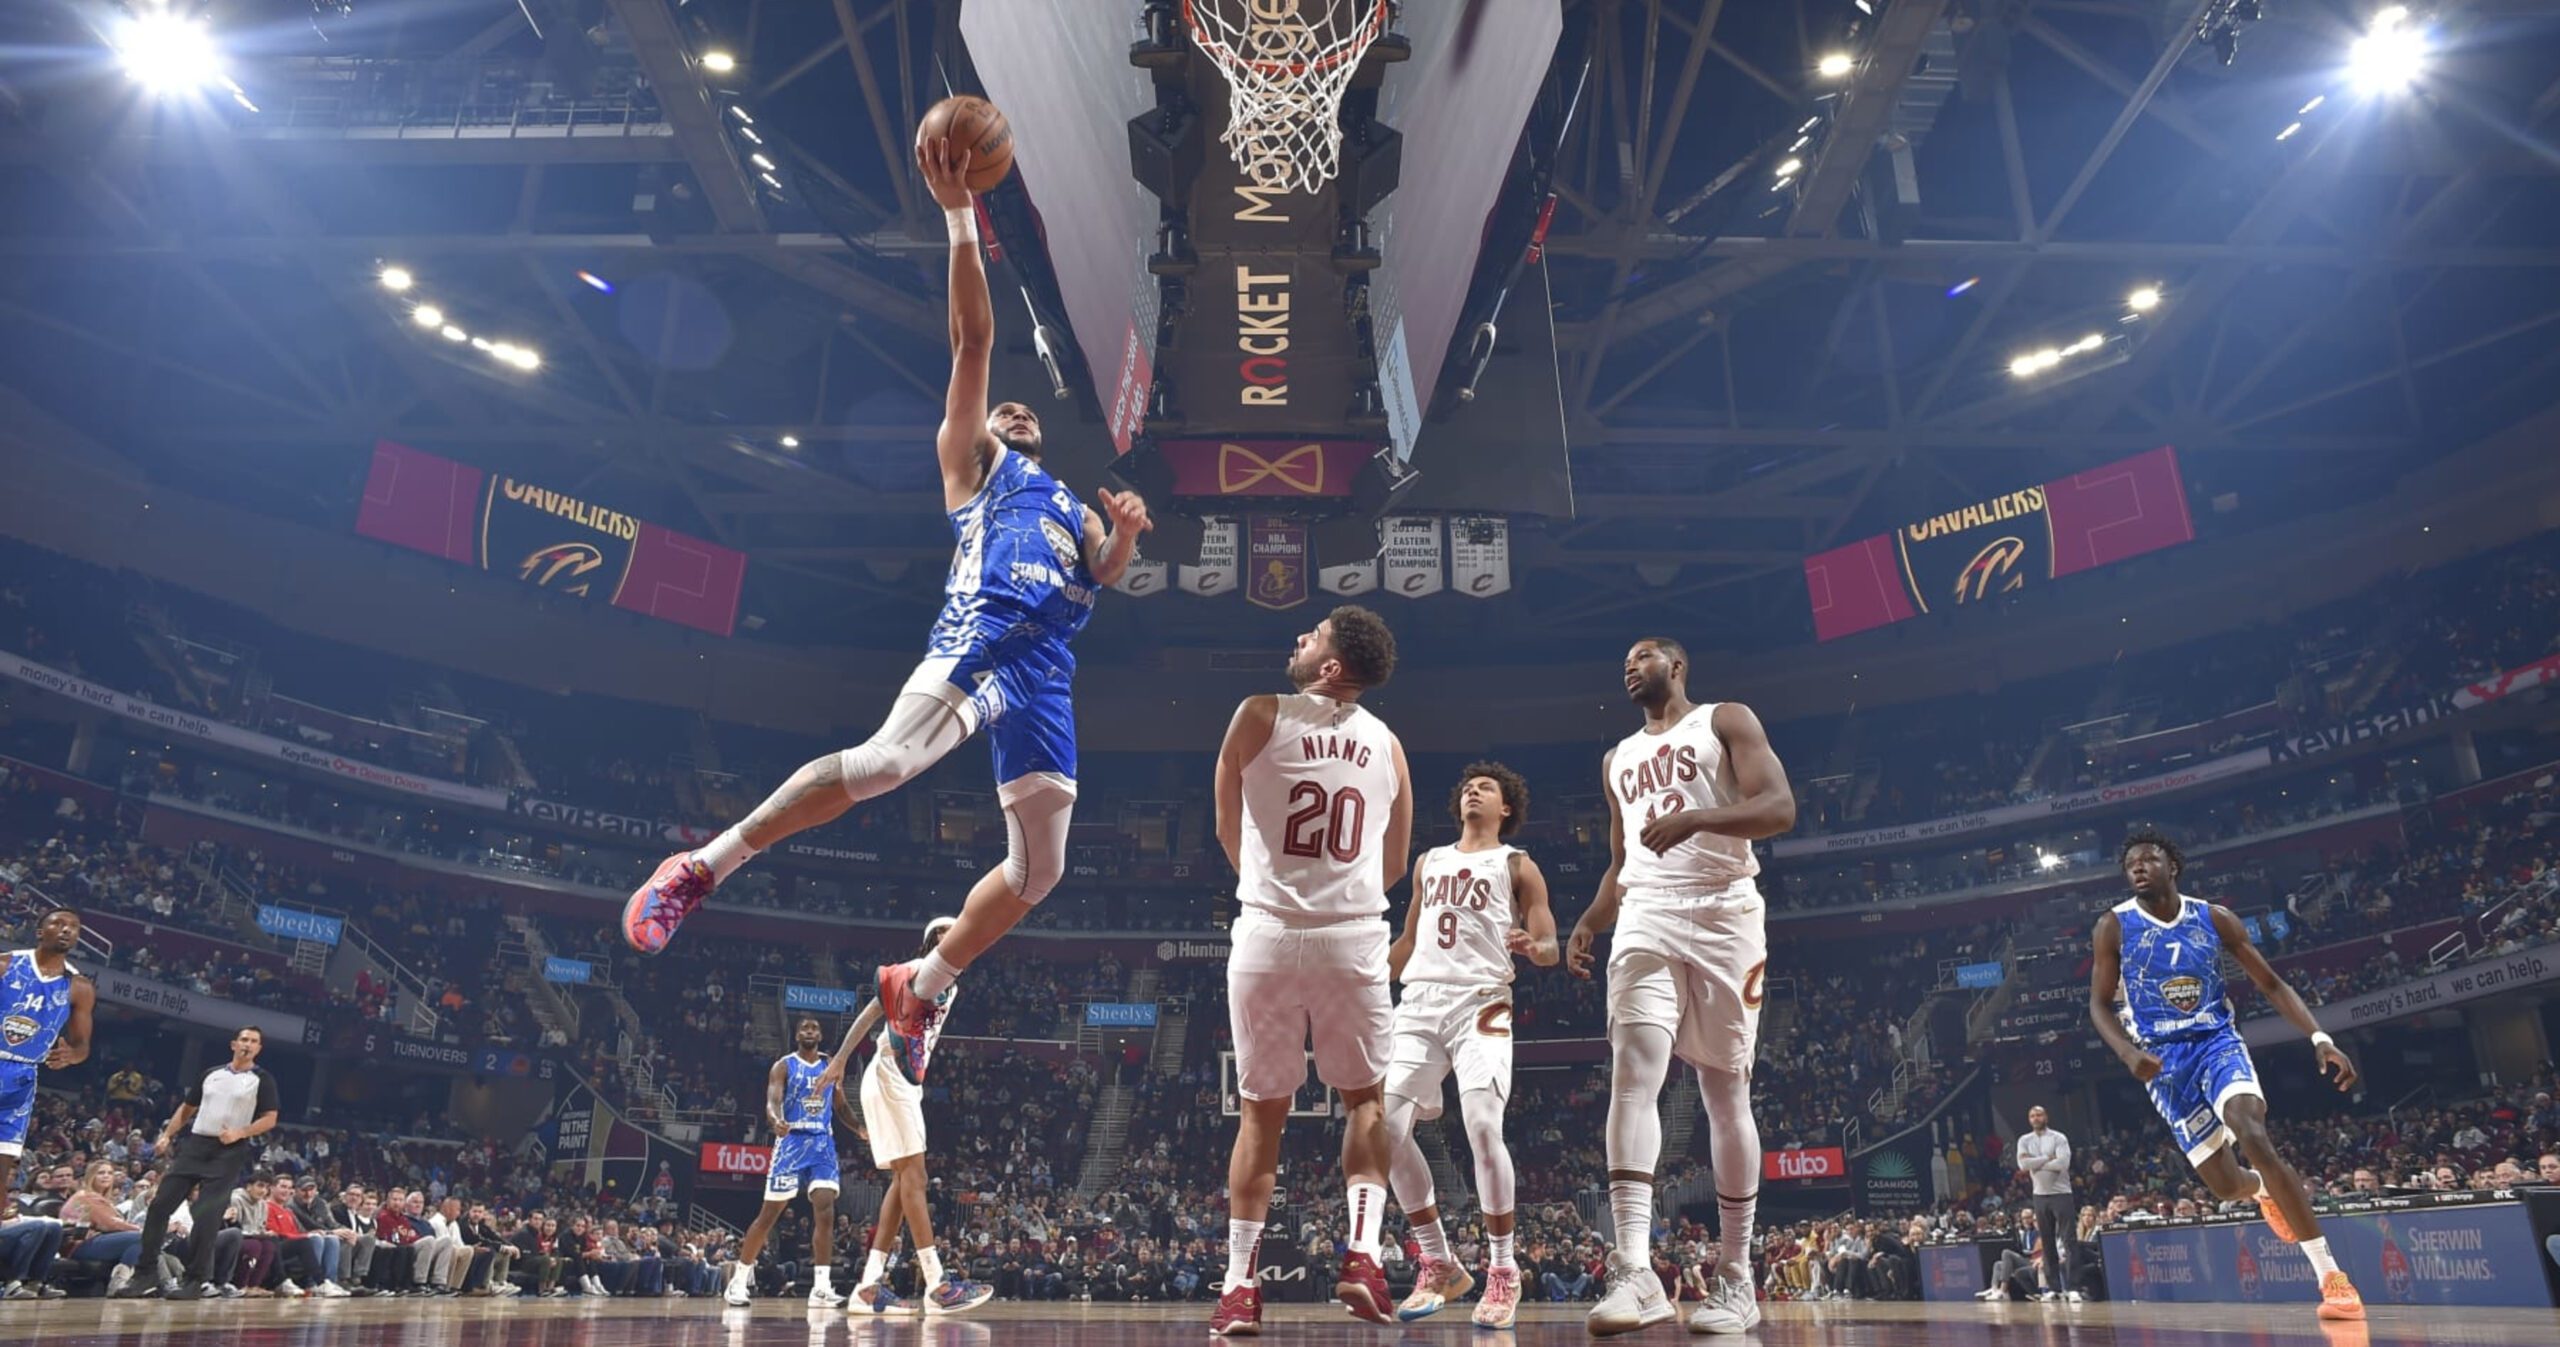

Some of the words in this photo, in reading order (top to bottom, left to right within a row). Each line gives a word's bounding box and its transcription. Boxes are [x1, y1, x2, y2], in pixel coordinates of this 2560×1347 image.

[1237, 266, 1290, 405] ROCKET
[503, 478, 636, 540] CAVALIERS
[1051, 490, 1072, 513] 4
[1910, 487, 2044, 542] CAVALIERS
[1252, 543, 1302, 553] CHAMPIONS
[1268, 534, 1287, 543] NBA
[1393, 536, 1431, 545] EASTERN
[1201, 557, 1232, 567] MPIONS
[1387, 547, 1439, 557] CONFERENCE
[1388, 559, 1438, 568] CHAMPIONS
[19, 665, 78, 693] money's
[82, 685, 115, 706] hard.
[127, 702, 146, 716] we
[150, 708, 174, 725] can
[178, 714, 213, 736] help.
[281, 746, 331, 769] KeyBank
[1302, 734, 1372, 769] NIANG
[1619, 743, 1698, 805] CAVS
[1283, 780, 1366, 864] 20
[1827, 833, 1876, 849] money's
[1879, 830, 1909, 843] hard.
[1919, 826, 1935, 836] we
[1938, 822, 1958, 834] can
[1962, 815, 1989, 829] help.
[1173, 866, 1189, 878] 23
[1424, 869, 1491, 911] CAVS
[259, 907, 338, 939] Sheely's
[1437, 912, 1458, 949] 9
[2164, 941, 2182, 966] 7
[112, 980, 131, 997] we
[134, 987, 158, 1003] can
[161, 993, 191, 1014] help.
[787, 987, 851, 1007] Sheely's
[2350, 993, 2404, 1021] money's
[2405, 982, 2441, 1007] hard.
[2451, 977, 2473, 994] we
[2476, 968, 2505, 988] can
[2507, 956, 2549, 982] help.
[23, 993, 45, 1012] 14
[1088, 1005, 1152, 1023] Sheely's
[364, 1035, 376, 1052] 5
[393, 1040, 468, 1064] TURNOVERS
[485, 1054, 496, 1070] 2
[2035, 1060, 2053, 1075] 23
[560, 1120, 571, 1134] IN
[571, 1119, 590, 1133] THE
[2173, 1118, 2191, 1143] 7
[558, 1134, 588, 1150] PAINT
[717, 1145, 767, 1171] fubo
[1777, 1151, 1829, 1176] fubo
[774, 1175, 787, 1189] 15
[1867, 1180, 1919, 1189] CASAMIGOS
[2258, 1235, 2303, 1258] SHERW
[2408, 1227, 2482, 1251] SHERWIN
[2145, 1242, 2188, 1262] SHERWIN
[2146, 1265, 2193, 1284] WILLIAMS
[2411, 1255, 2491, 1282] WILLIAMS
